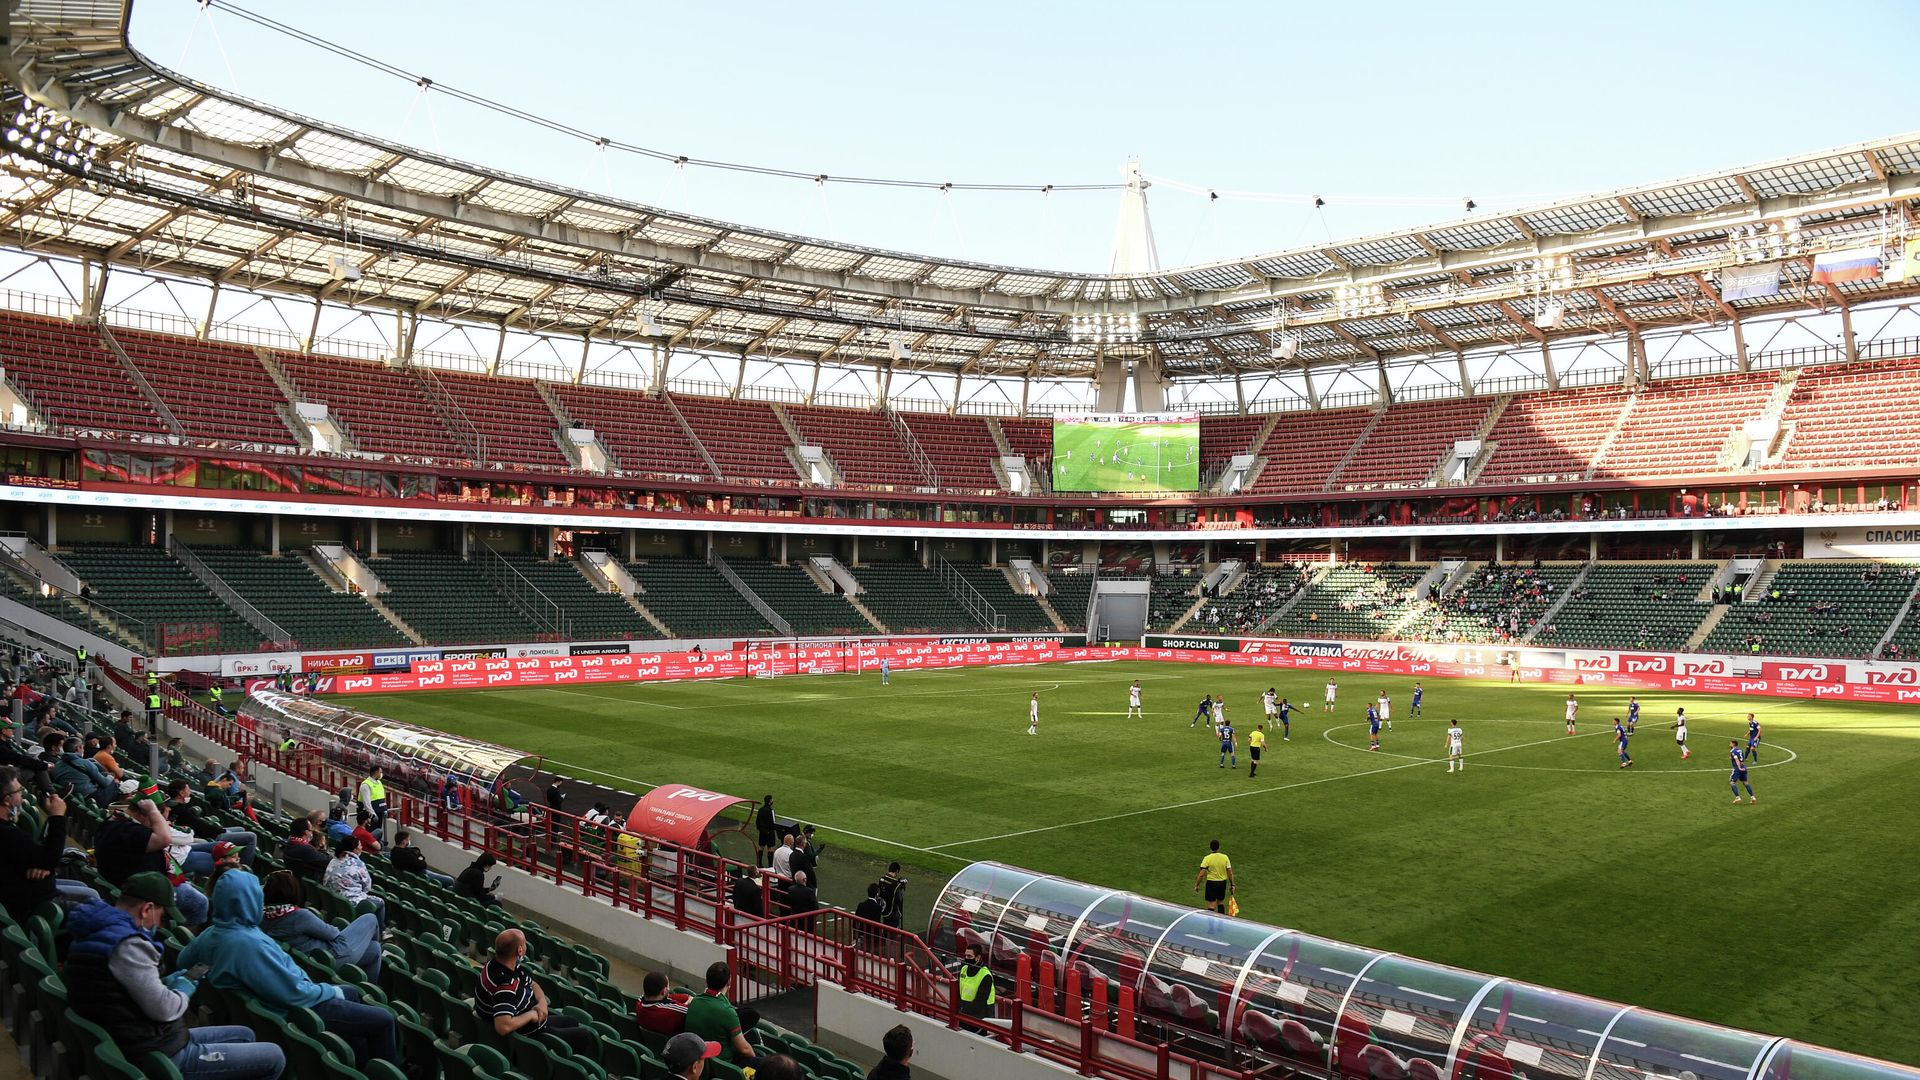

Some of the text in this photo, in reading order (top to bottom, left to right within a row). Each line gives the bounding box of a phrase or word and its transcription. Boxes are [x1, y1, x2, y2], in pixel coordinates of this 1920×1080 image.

[1737, 274, 1776, 287] RESPECT
[1163, 640, 1220, 649] SHOP.FCLM.RU
[308, 659, 334, 667] НИИАС
[444, 652, 505, 660] SPORT24.RU
[1574, 656, 1611, 670] РЖД
[1626, 658, 1667, 672] РЖД
[1684, 660, 1724, 676] РЖД
[1779, 665, 1828, 680] РЖД
[1865, 668, 1917, 684] РЖД
[250, 677, 333, 693] САСН
[1224, 731, 1230, 739] 15
[667, 788, 727, 802] РЖД
